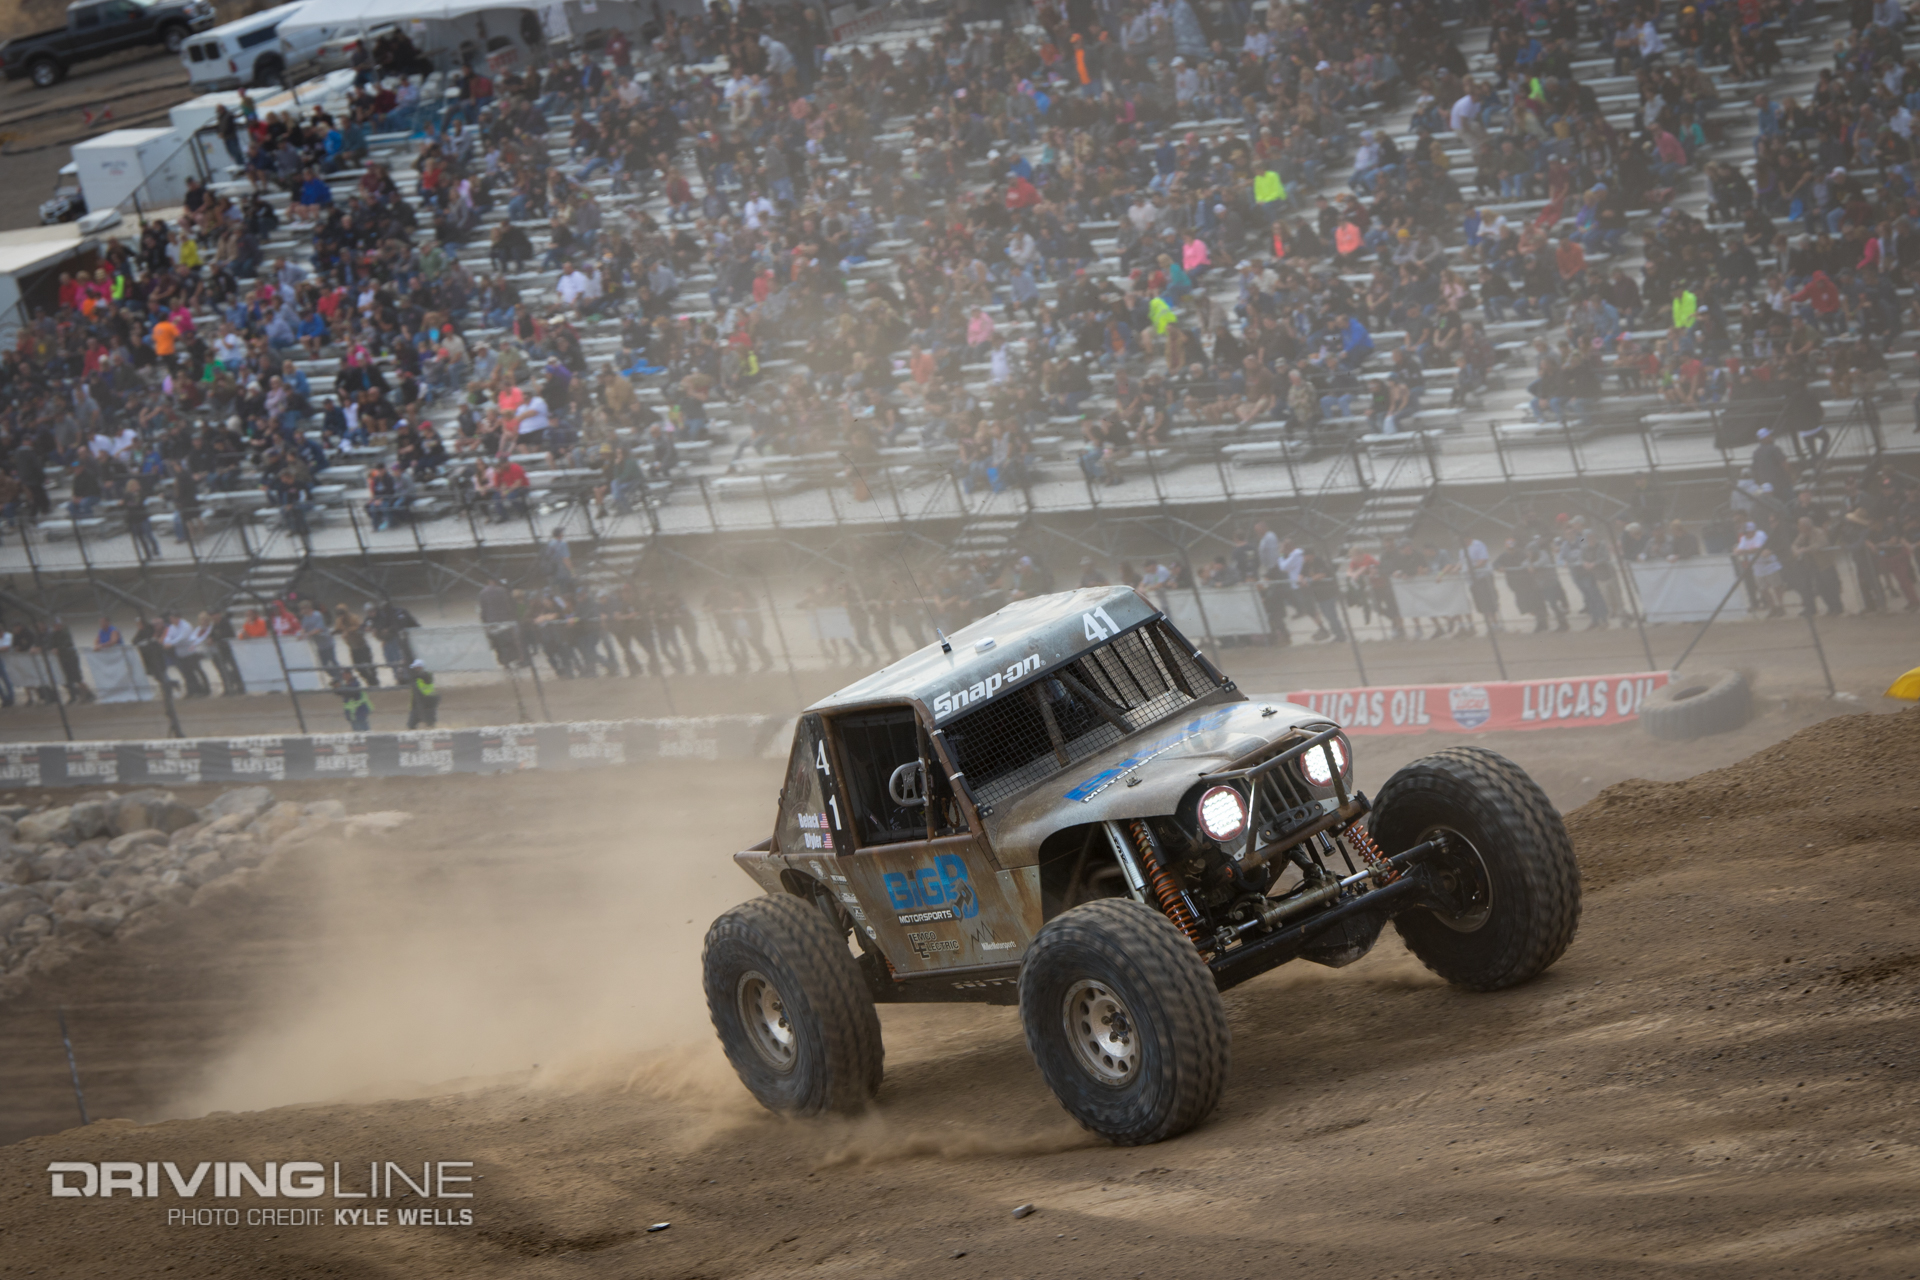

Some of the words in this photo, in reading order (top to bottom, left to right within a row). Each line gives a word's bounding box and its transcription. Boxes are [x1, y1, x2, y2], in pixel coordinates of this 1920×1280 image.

[1083, 606, 1121, 642] 41
[933, 653, 1041, 720] Snap-on
[1521, 680, 1609, 720] LUCAS
[1391, 689, 1431, 726] OIL
[899, 910, 953, 924] MOTORSPORTS
[908, 931, 937, 953] LEMCO
[917, 940, 960, 959] ELECTRIC
